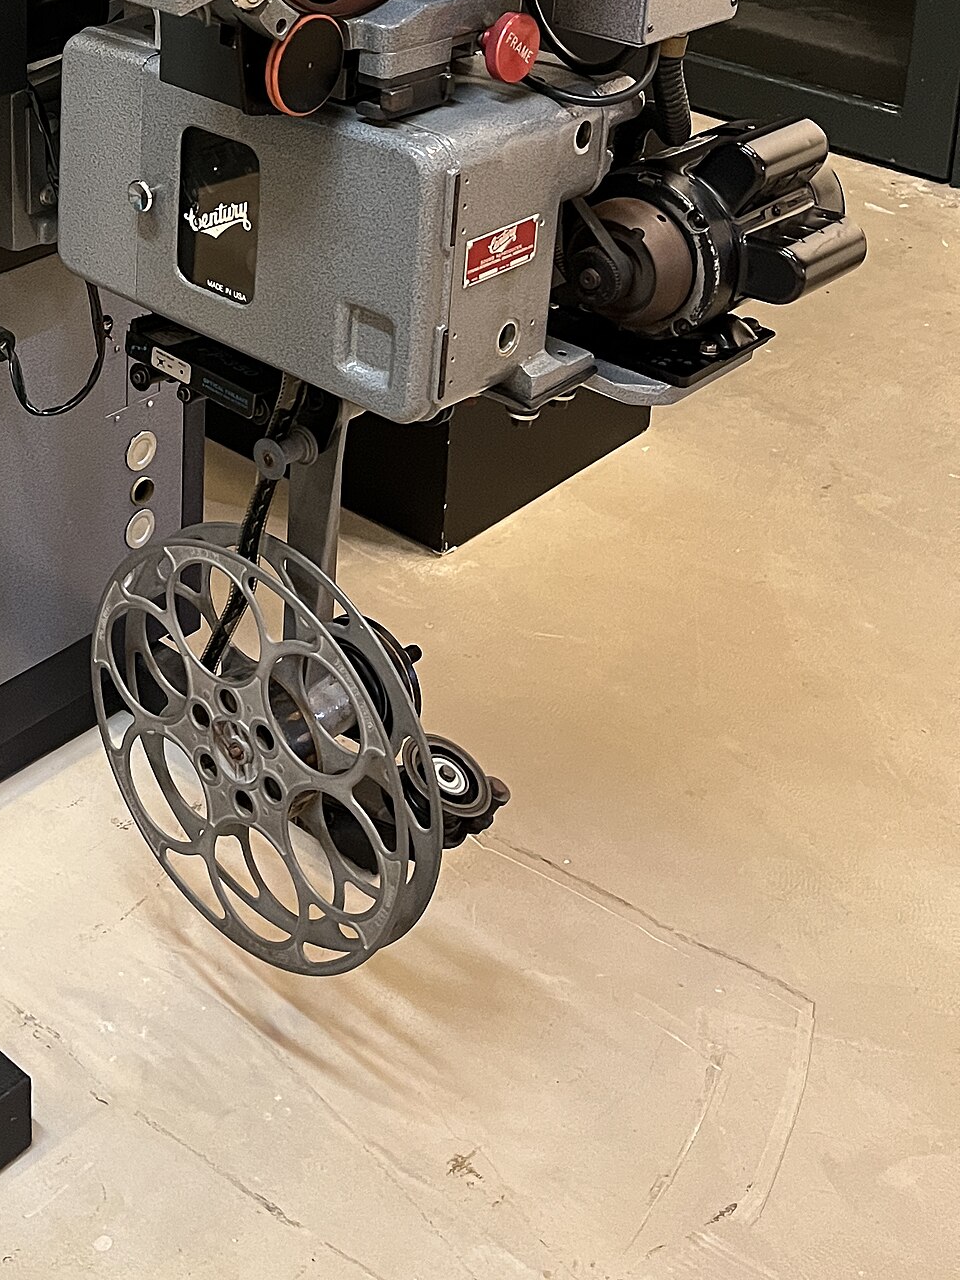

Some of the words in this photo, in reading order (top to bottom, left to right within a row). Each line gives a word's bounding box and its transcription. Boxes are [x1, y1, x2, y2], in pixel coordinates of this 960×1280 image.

[505, 31, 534, 64] FRAME
[183, 201, 252, 235] Century
[206, 279, 224, 293] MADE
[224, 287, 232, 296] IN
[233, 290, 247, 302] USA
